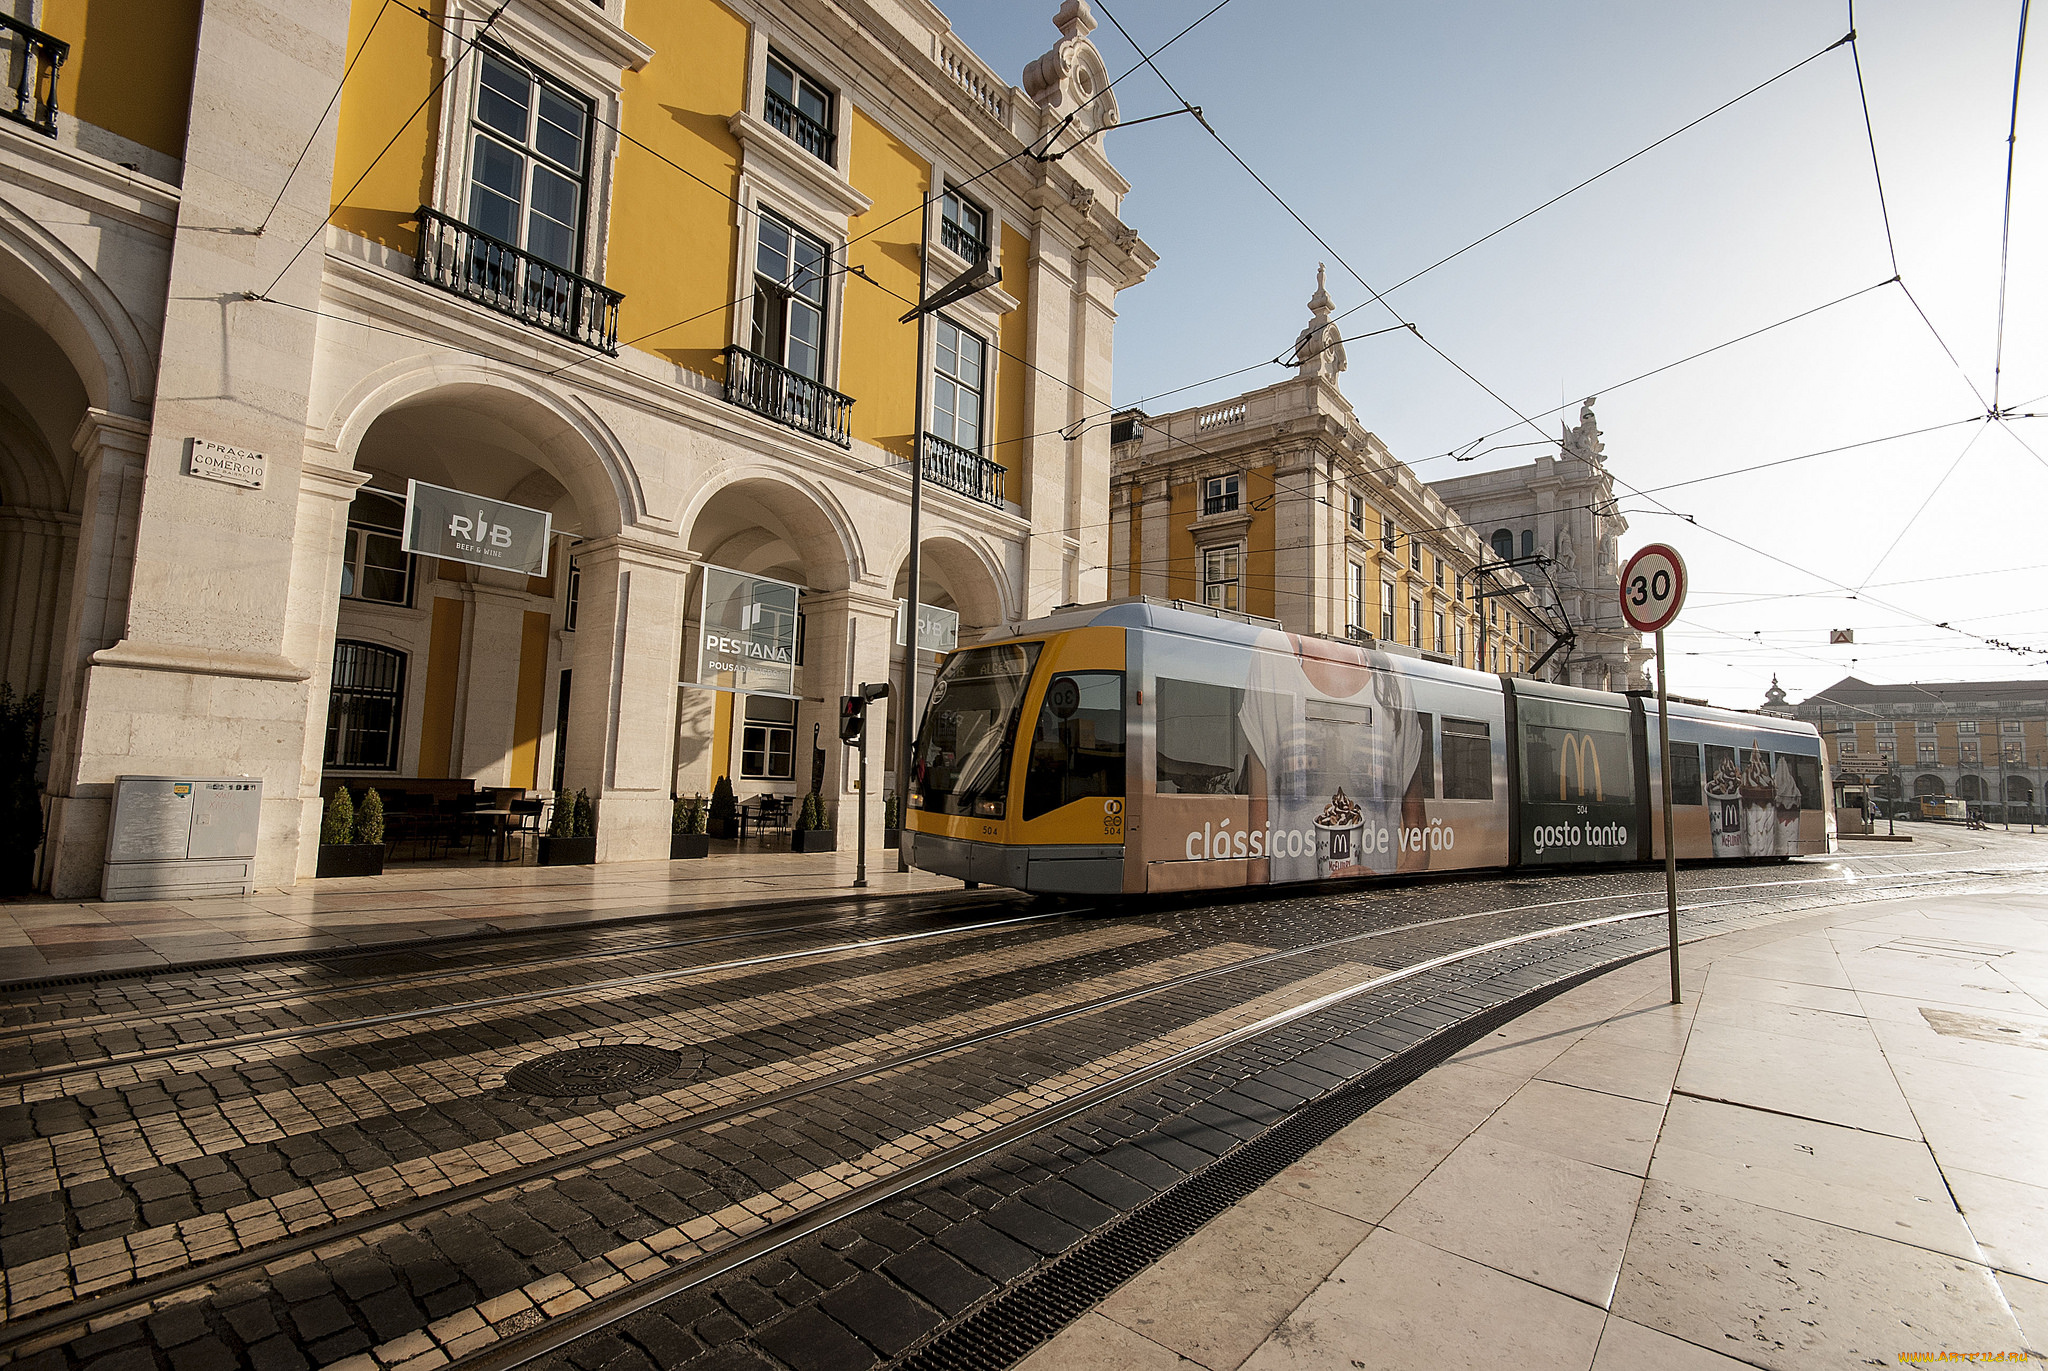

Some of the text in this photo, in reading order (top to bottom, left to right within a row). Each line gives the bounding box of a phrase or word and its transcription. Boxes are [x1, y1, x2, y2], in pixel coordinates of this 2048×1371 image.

[206, 442, 255, 460] PRAÇA
[194, 454, 263, 476] COMERCIO
[448, 509, 512, 548] RIB
[456, 542, 474, 552] BEEF
[483, 548, 502, 558] WINE
[1631, 569, 1670, 606] 30
[706, 634, 788, 662] PESTANA
[709, 660, 752, 673] POUSADA
[1576, 805, 1588, 814] 504
[982, 825, 998, 835] 504
[1104, 827, 1121, 835] 504
[1186, 817, 1454, 860] clássicos de verão
[1533, 820, 1627, 854] gosto tanto
